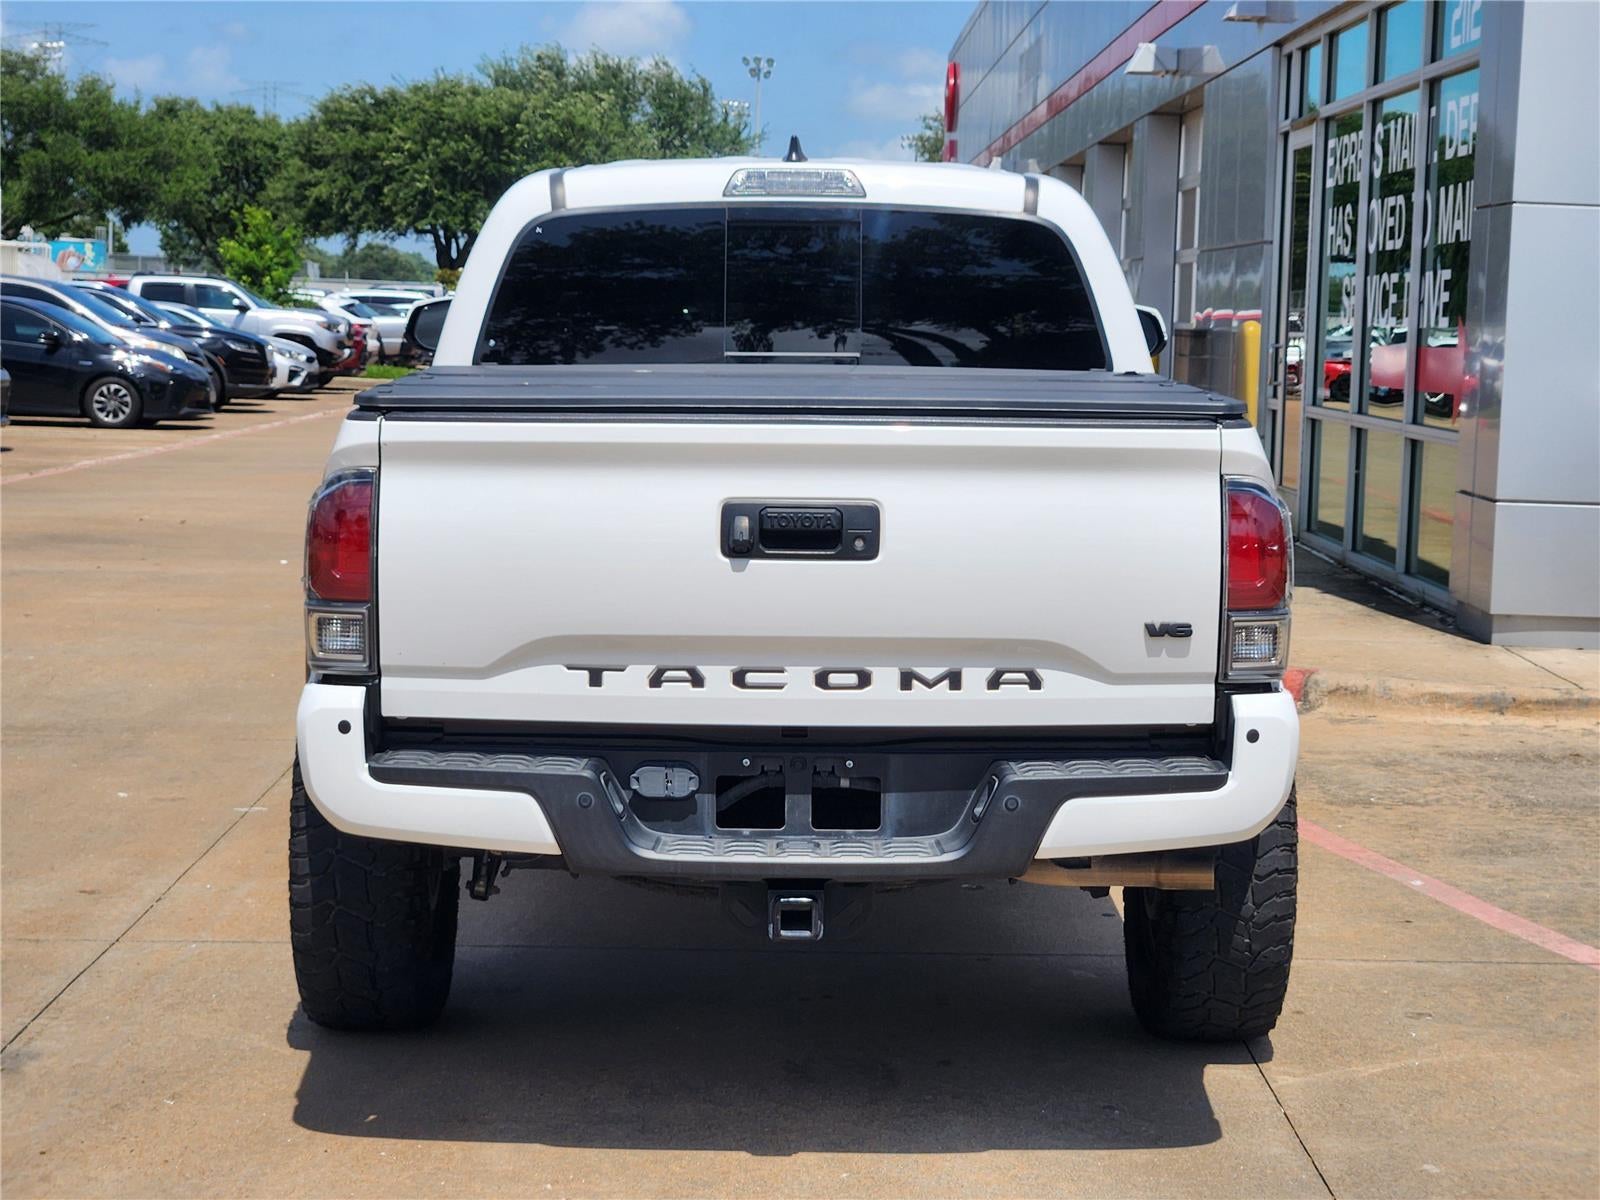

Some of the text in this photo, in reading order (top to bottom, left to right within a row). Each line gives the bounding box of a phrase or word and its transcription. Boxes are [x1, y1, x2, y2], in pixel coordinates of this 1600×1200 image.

[1326, 122, 1384, 188] EXPRES
[1327, 203, 1353, 256] HAS
[1368, 194, 1405, 254] OVED
[1340, 272, 1399, 328] SEVICE
[767, 512, 836, 529] TOYOTA
[1144, 621, 1193, 638] V6
[562, 664, 1044, 692] TACOMA
